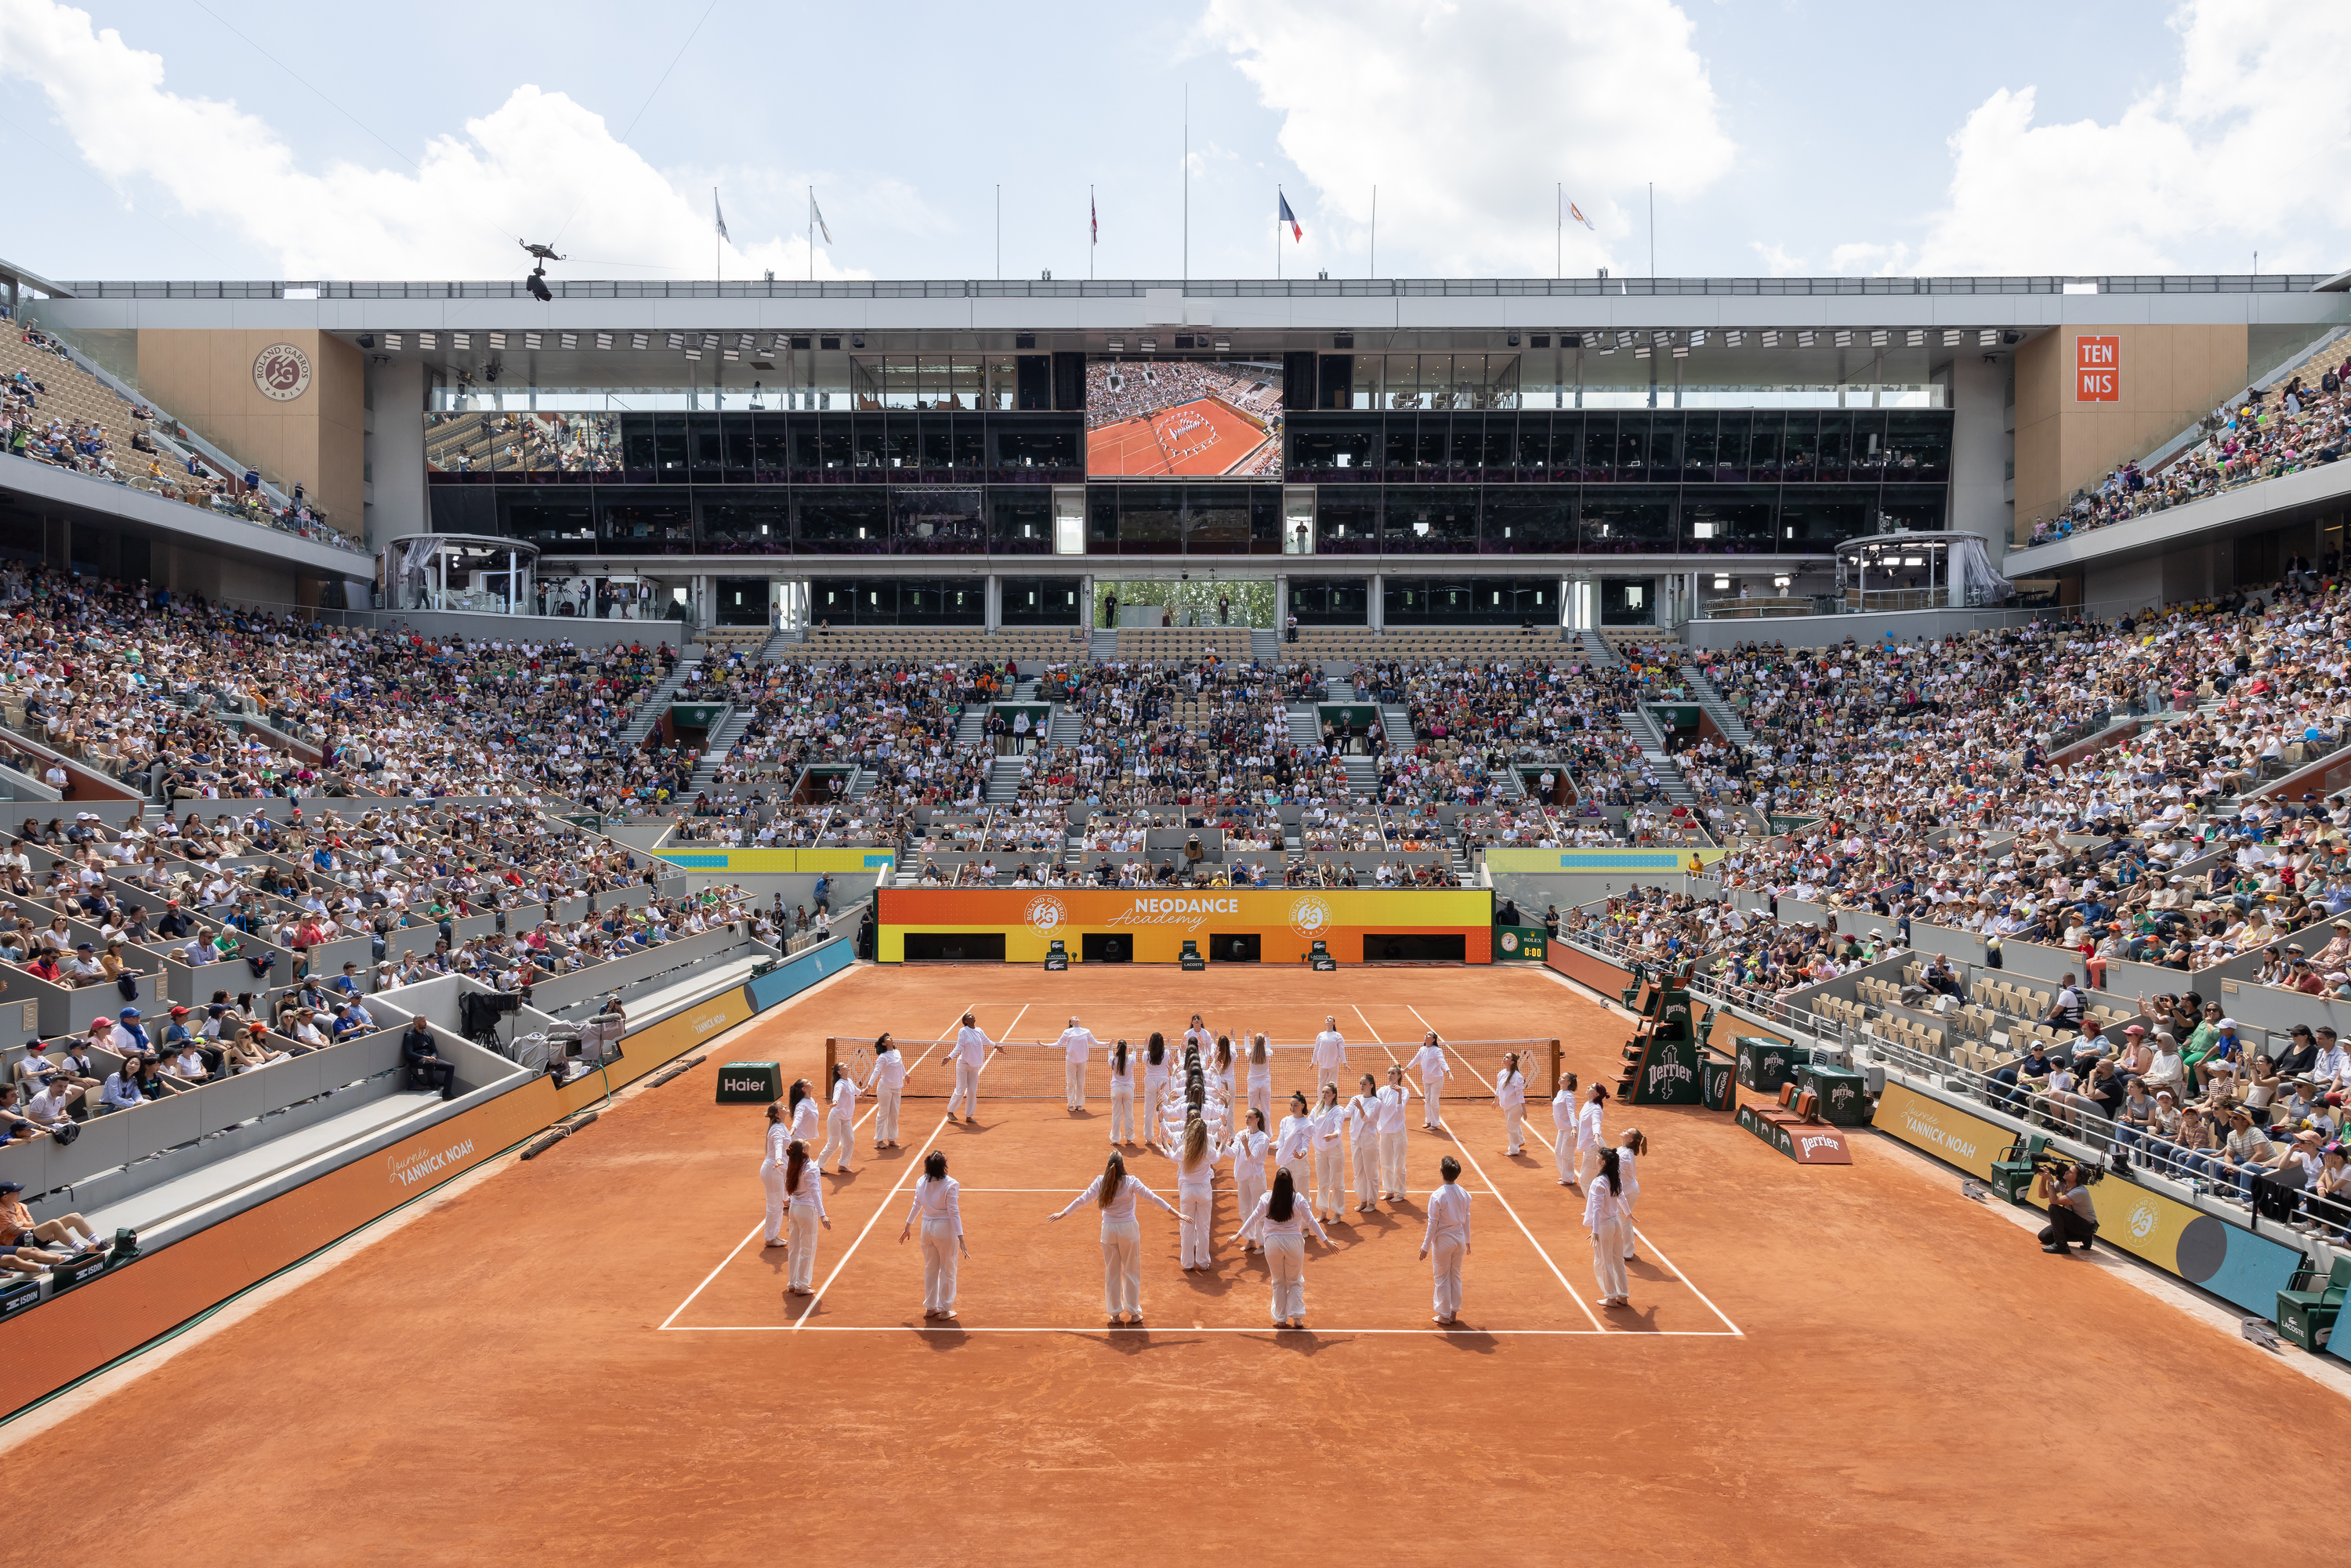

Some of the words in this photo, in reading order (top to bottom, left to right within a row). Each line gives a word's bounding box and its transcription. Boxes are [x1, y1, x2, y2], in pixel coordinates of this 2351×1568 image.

[256, 346, 281, 379] ROLAND
[284, 346, 309, 378] GARROS
[2082, 345, 2112, 363] TEN
[265, 386, 301, 398] PARIS
[2084, 375, 2112, 393] NIS
[1773, 820, 1790, 833] Haier
[1027, 896, 1045, 921] ROLAND
[1046, 896, 1065, 921] GARROS
[1136, 898, 1238, 913] NEODANCE
[1291, 897, 1310, 922] ROLAND
[1311, 897, 1330, 922] GARROS
[1105, 907, 1208, 932] Academy
[1524, 947, 1541, 958] 0:00
[694, 1018, 715, 1034] YANNICK
[713, 1012, 726, 1025] NOAH
[724, 1077, 766, 1092] Haier
[1900, 1099, 1940, 1125] Journée
[1905, 1115, 1947, 1146] YANNICK
[1945, 1134, 1977, 1160] NOAH
[387, 1147, 430, 1183] Journée
[397, 1152, 447, 1187] YANNICK
[444, 1138, 475, 1164] NOAH
[1994, 1183, 2009, 1195] LACOSTE
[88, 1260, 103, 1276] ISDIN
[20, 1290, 38, 1306] ISDIN
[2281, 1320, 2305, 1338] LACOSTE
